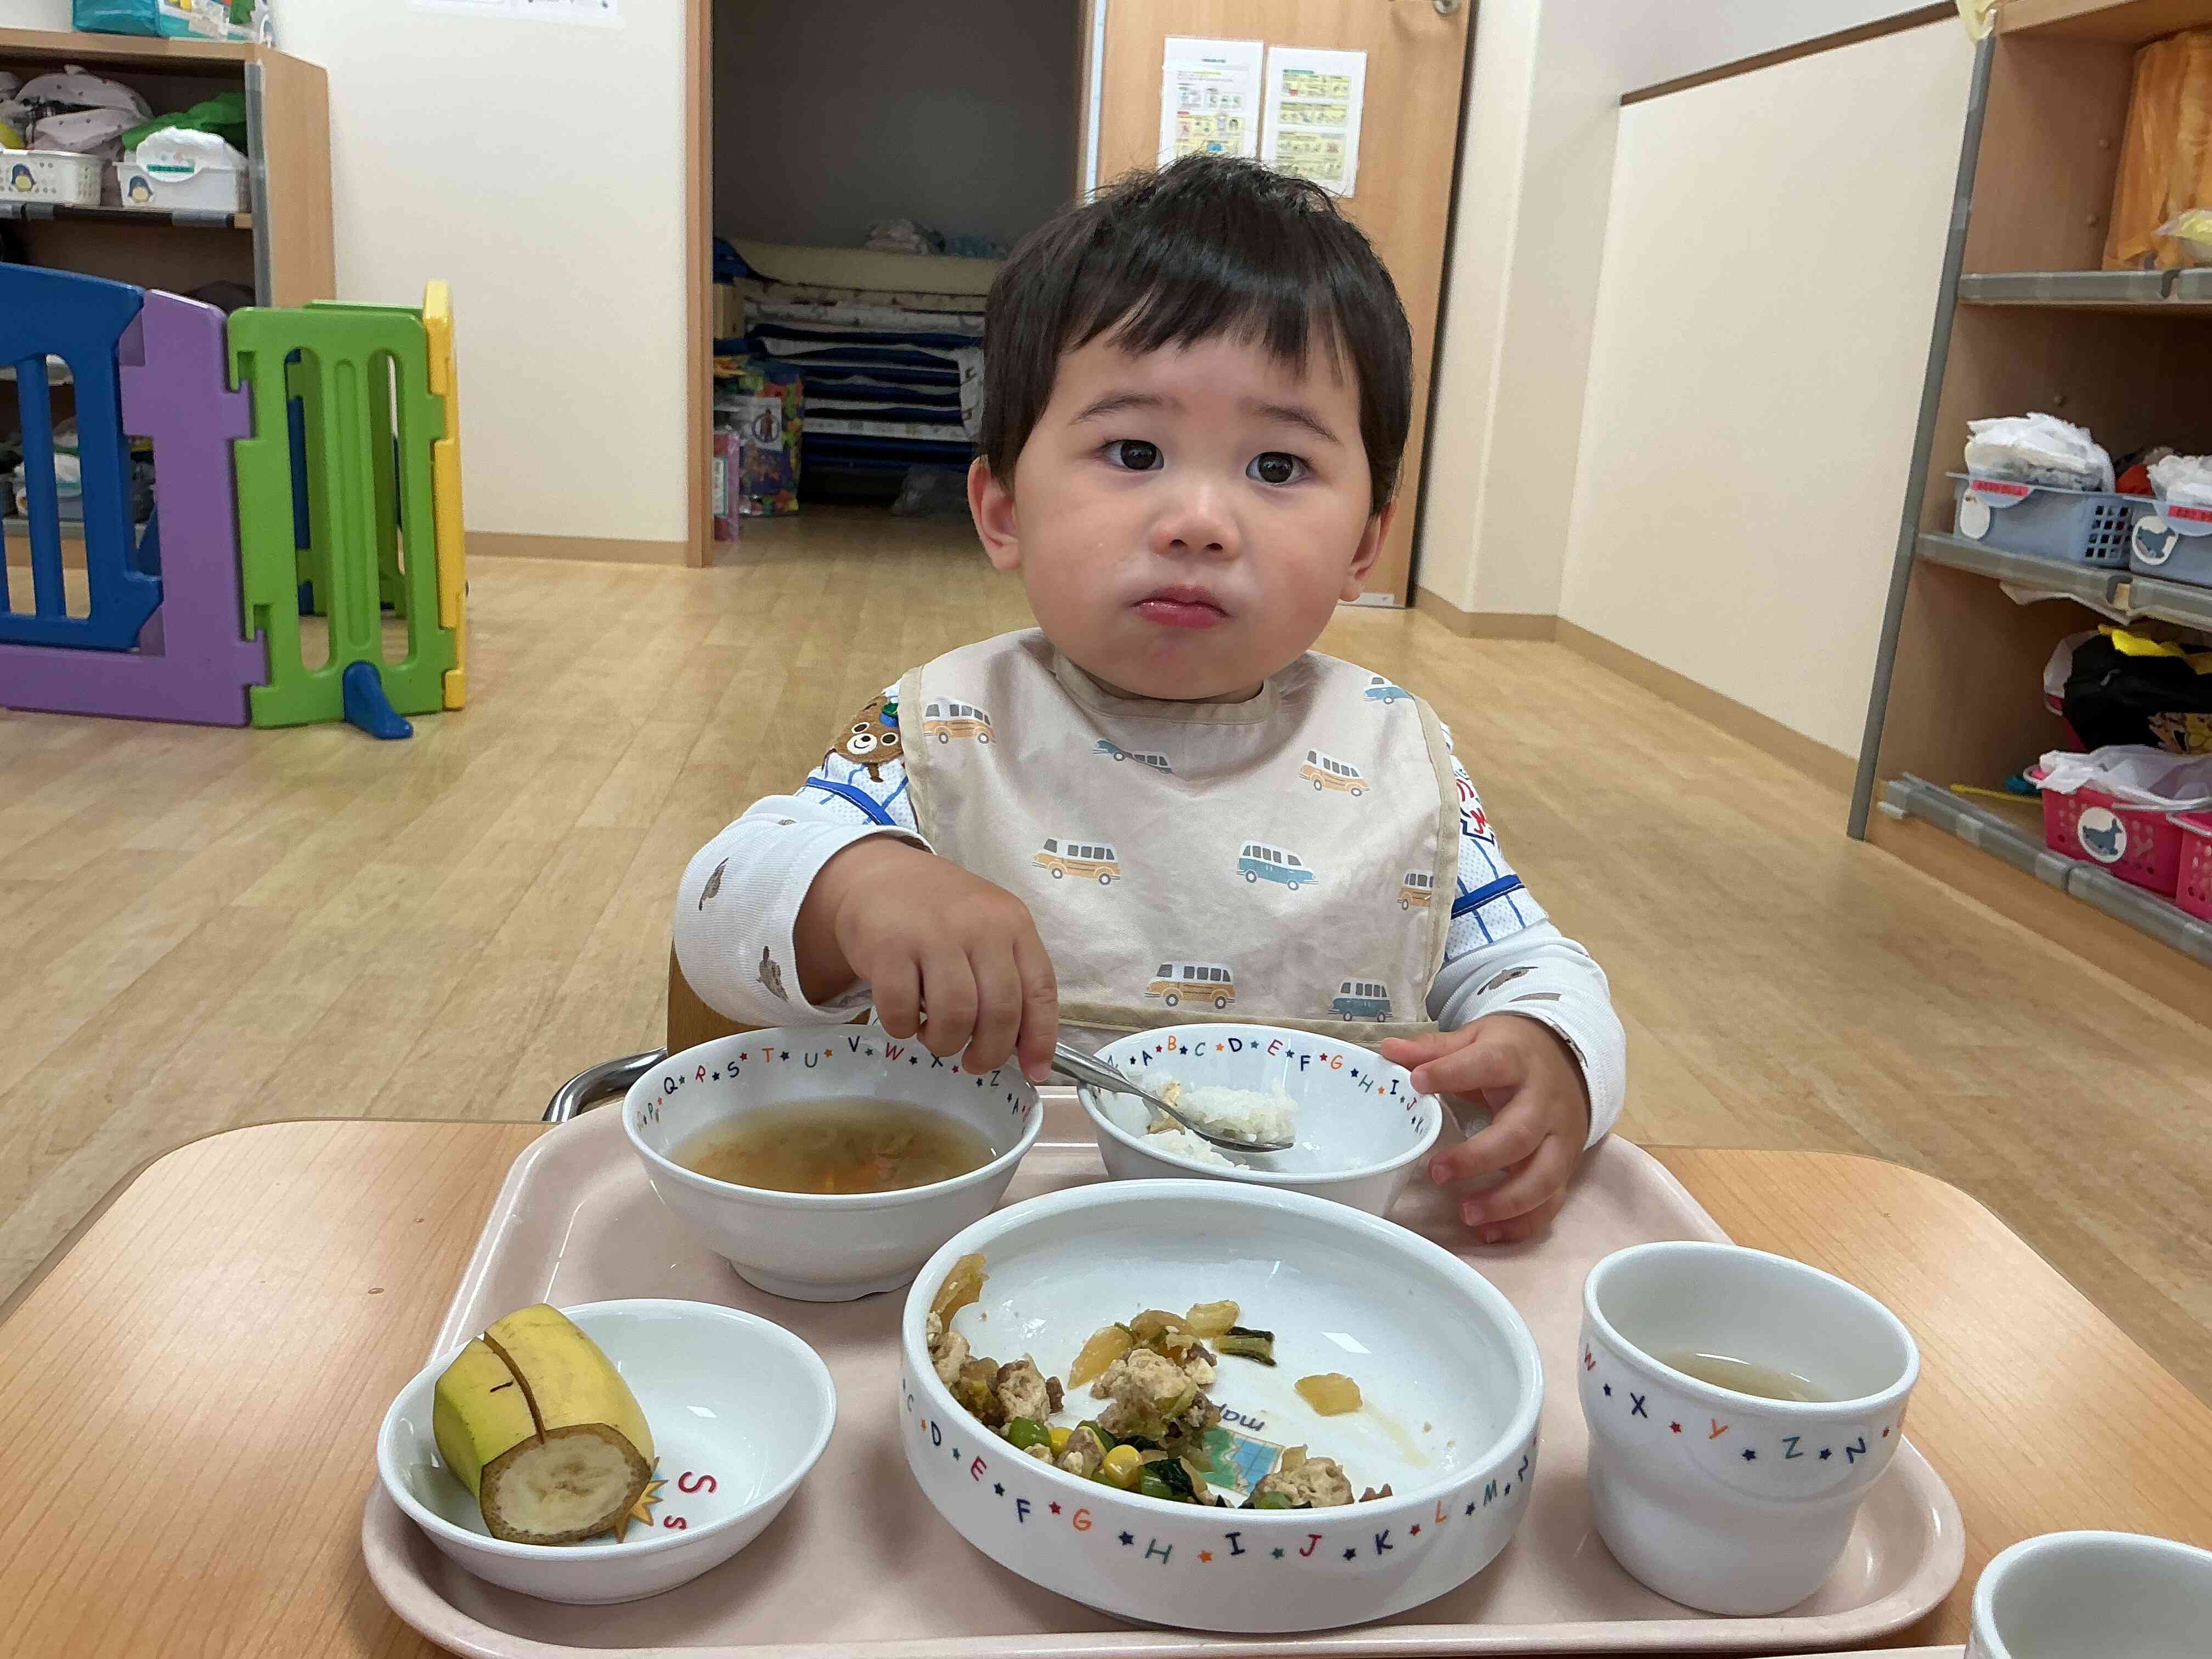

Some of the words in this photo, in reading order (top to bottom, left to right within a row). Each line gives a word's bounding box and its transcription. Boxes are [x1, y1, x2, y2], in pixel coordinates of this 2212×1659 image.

[664, 1077, 678, 1094] Q
[696, 1065, 706, 1082] R
[727, 1062, 740, 1078] S
[762, 1048, 774, 1063] T
[805, 1053, 818, 1068] U
[848, 1036, 860, 1052] V
[885, 1042, 904, 1060] W
[930, 1054, 944, 1069] X
[990, 1070, 1001, 1086] Z
[1012, 1097, 1019, 1115] A
[1142, 1051, 1153, 1066] A
[1167, 1035, 1176, 1051] B
[1195, 1042, 1205, 1057] C
[1228, 1038, 1242, 1052] D
[1267, 1039, 1283, 1056] E
[1301, 1055, 1311, 1071] F
[1330, 1055, 1343, 1070] G
[1358, 1075, 1374, 1092] H
[1390, 1080, 1399, 1094] I
[1407, 1097, 1417, 1110] J
[1630, 1392, 1647, 1418] X
[1709, 1419, 1729, 1440] Y
[1781, 1436, 1804, 1459] Z
[679, 1472, 716, 1493] S
[931, 1421, 941, 1446] D
[970, 1456, 986, 1481] E
[1017, 1498, 1030, 1523] F
[1073, 1509, 1092, 1532] G
[1145, 1538, 1172, 1565] H
[1224, 1532, 1245, 1556] I
[1300, 1534, 1322, 1557] J
[1375, 1530, 1393, 1555] K
[1435, 1501, 1448, 1523] L
